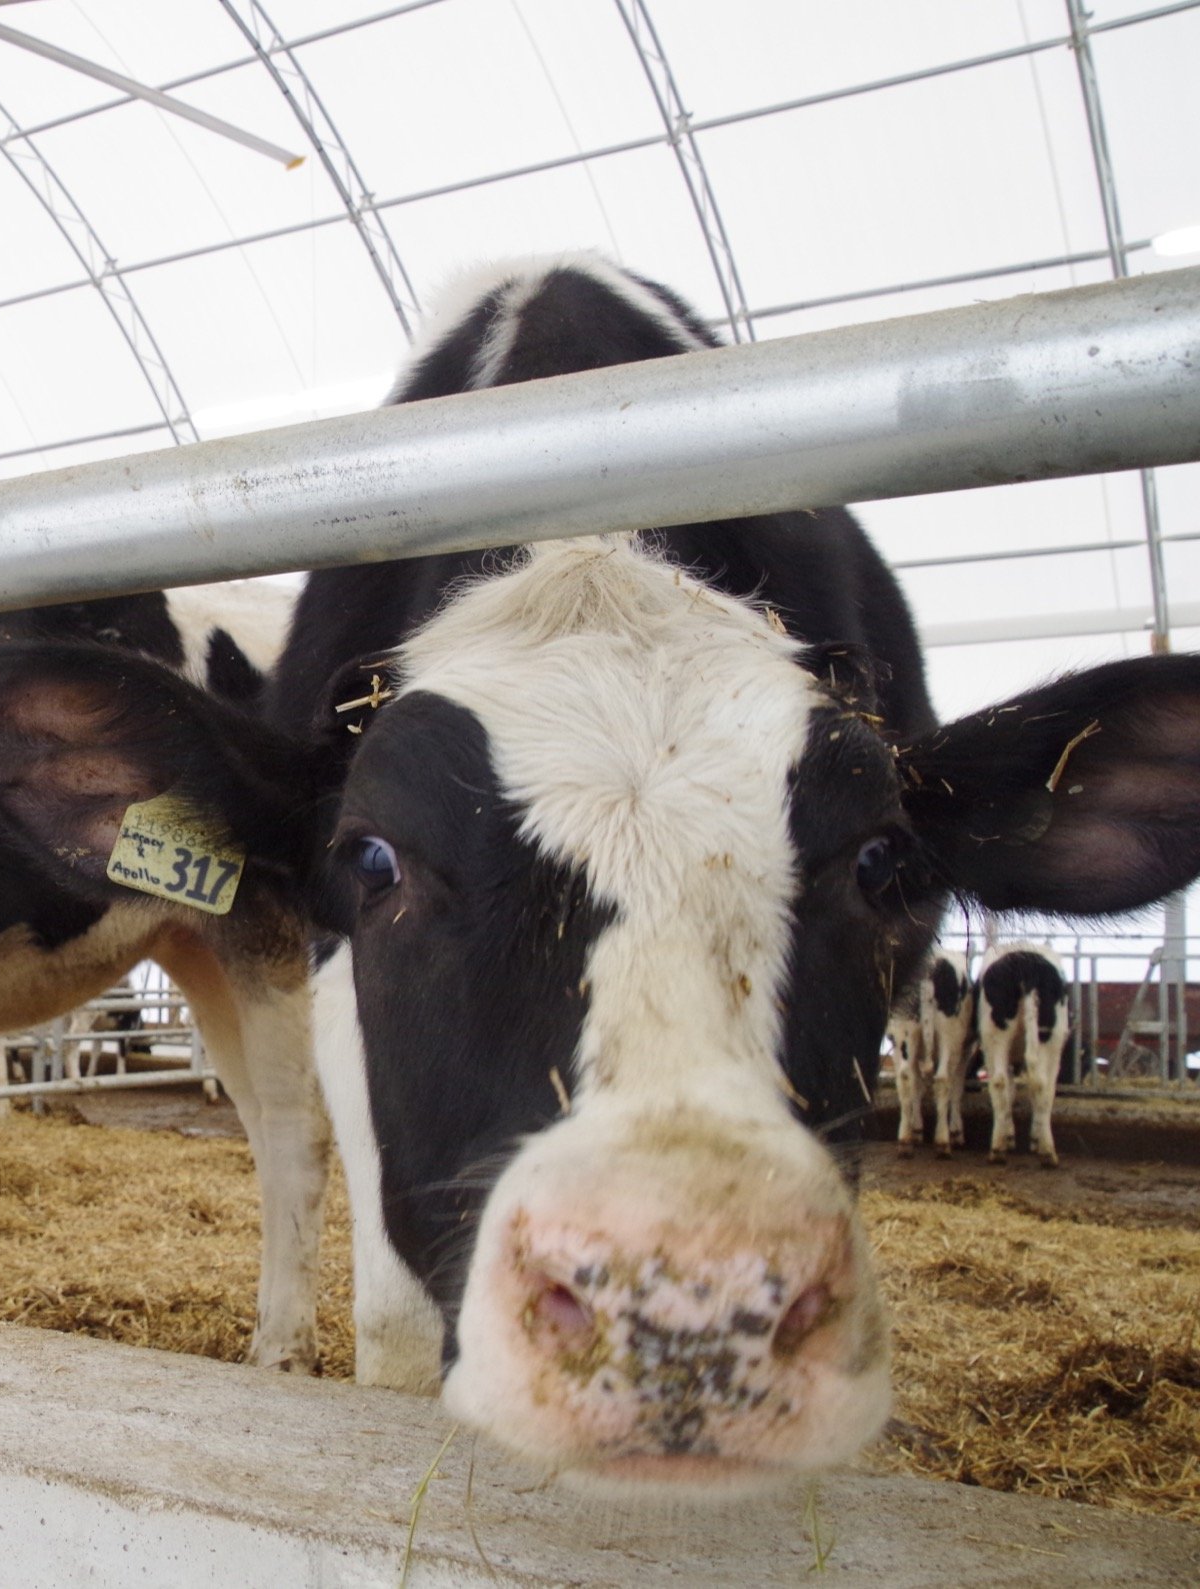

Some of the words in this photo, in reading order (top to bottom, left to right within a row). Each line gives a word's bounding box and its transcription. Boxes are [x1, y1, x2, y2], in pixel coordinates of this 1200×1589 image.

[122, 828, 165, 853] Legacy
[112, 861, 160, 885] Apollo
[164, 847, 240, 905] 317
